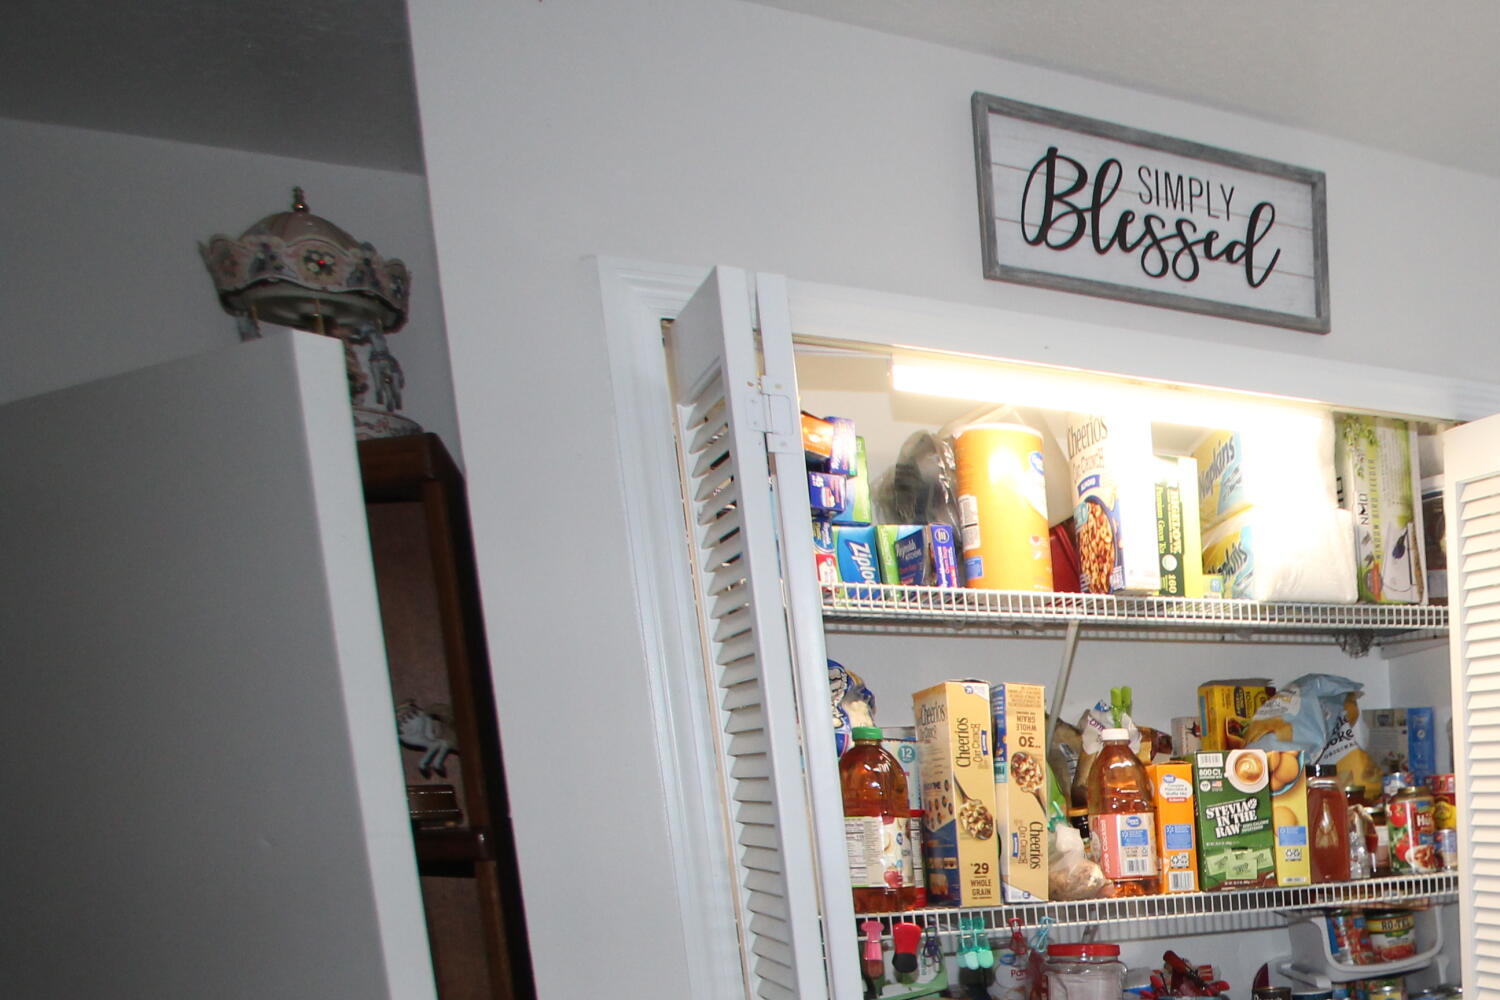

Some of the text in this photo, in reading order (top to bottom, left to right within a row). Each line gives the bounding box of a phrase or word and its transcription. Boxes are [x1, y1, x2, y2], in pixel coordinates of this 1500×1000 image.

[1137, 165, 1235, 222] SIMPLY
[1021, 146, 1281, 288] Blessed
[1067, 415, 1109, 460] Cheerios
[1168, 574, 1178, 594] 160
[1016, 714, 1036, 723] GRAIN
[1016, 723, 1037, 732] WHOLE
[956, 716, 971, 769] Cheerios
[1018, 735, 1036, 748] 30
[901, 747, 914, 760] 12
[1206, 801, 1249, 819] STEVIA
[1216, 809, 1257, 827] IN THE
[1215, 823, 1240, 839] RAW
[1029, 820, 1044, 870] Cheerios
[973, 862, 990, 875] 29
[970, 879, 992, 888] WHOLE
[972, 887, 992, 897] GRAIN
